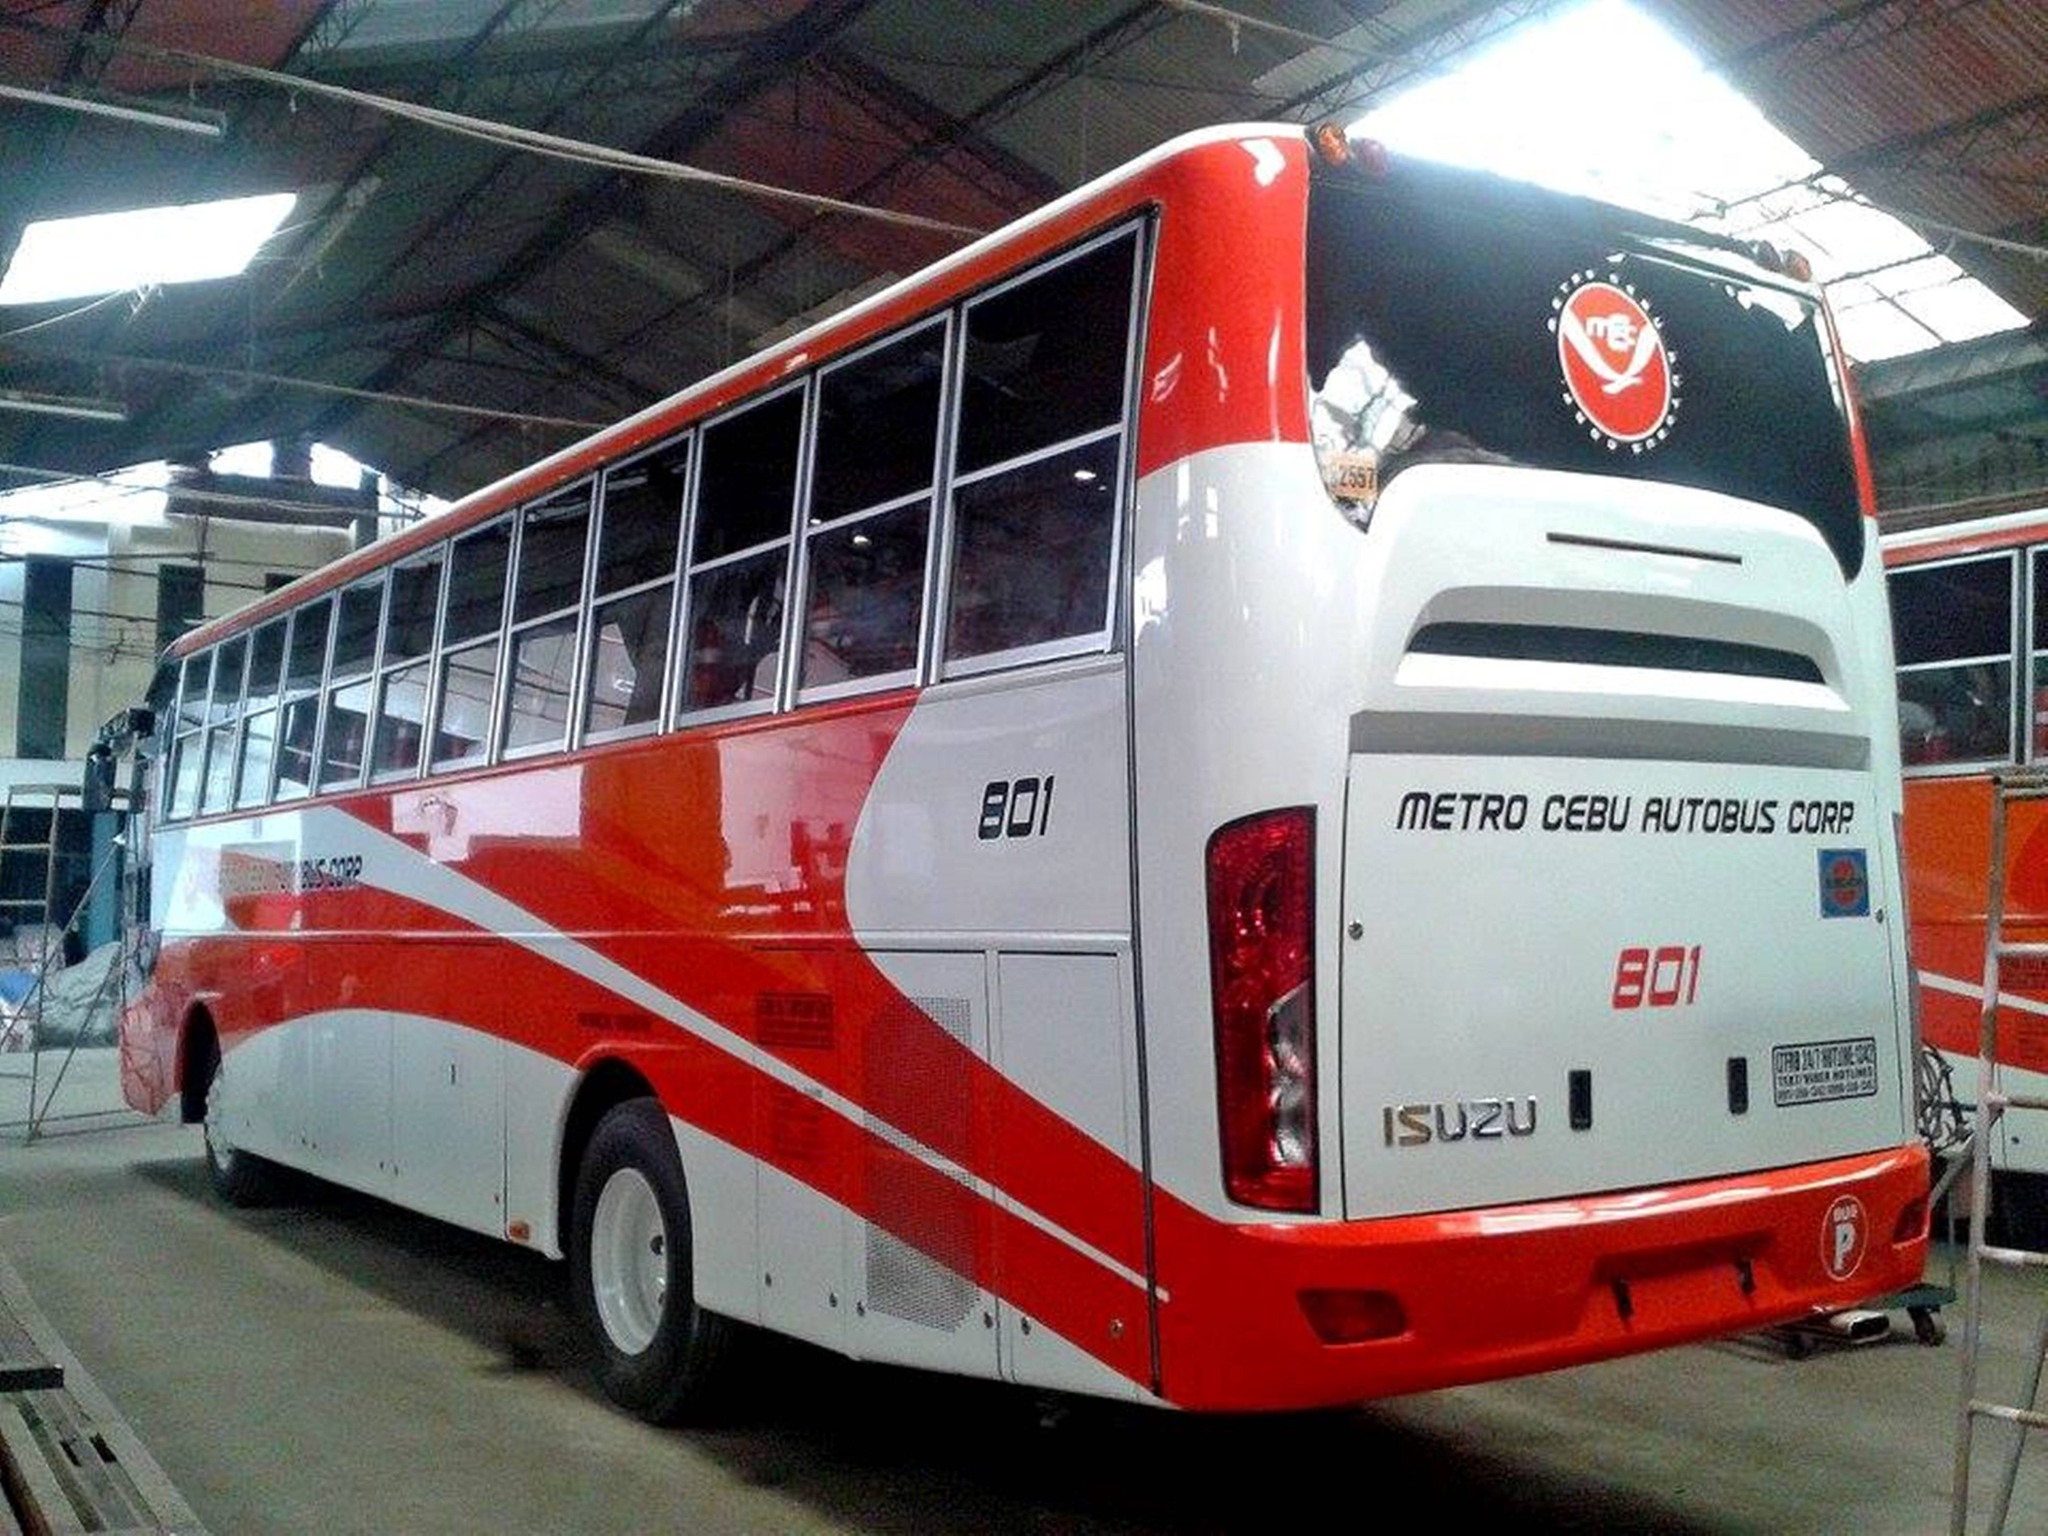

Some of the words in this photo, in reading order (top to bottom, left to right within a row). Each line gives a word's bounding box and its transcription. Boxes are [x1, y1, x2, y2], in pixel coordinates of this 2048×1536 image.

[978, 775, 1054, 840] 801
[1396, 791, 1528, 831] METRO
[1542, 793, 1632, 833] CEBU
[1641, 797, 1778, 834] AUTOBUS
[1787, 800, 1854, 834] CORP.
[1612, 945, 1701, 1010] 801
[1383, 1095, 1537, 1148] ISUZU
[1833, 1223, 1856, 1271] P
